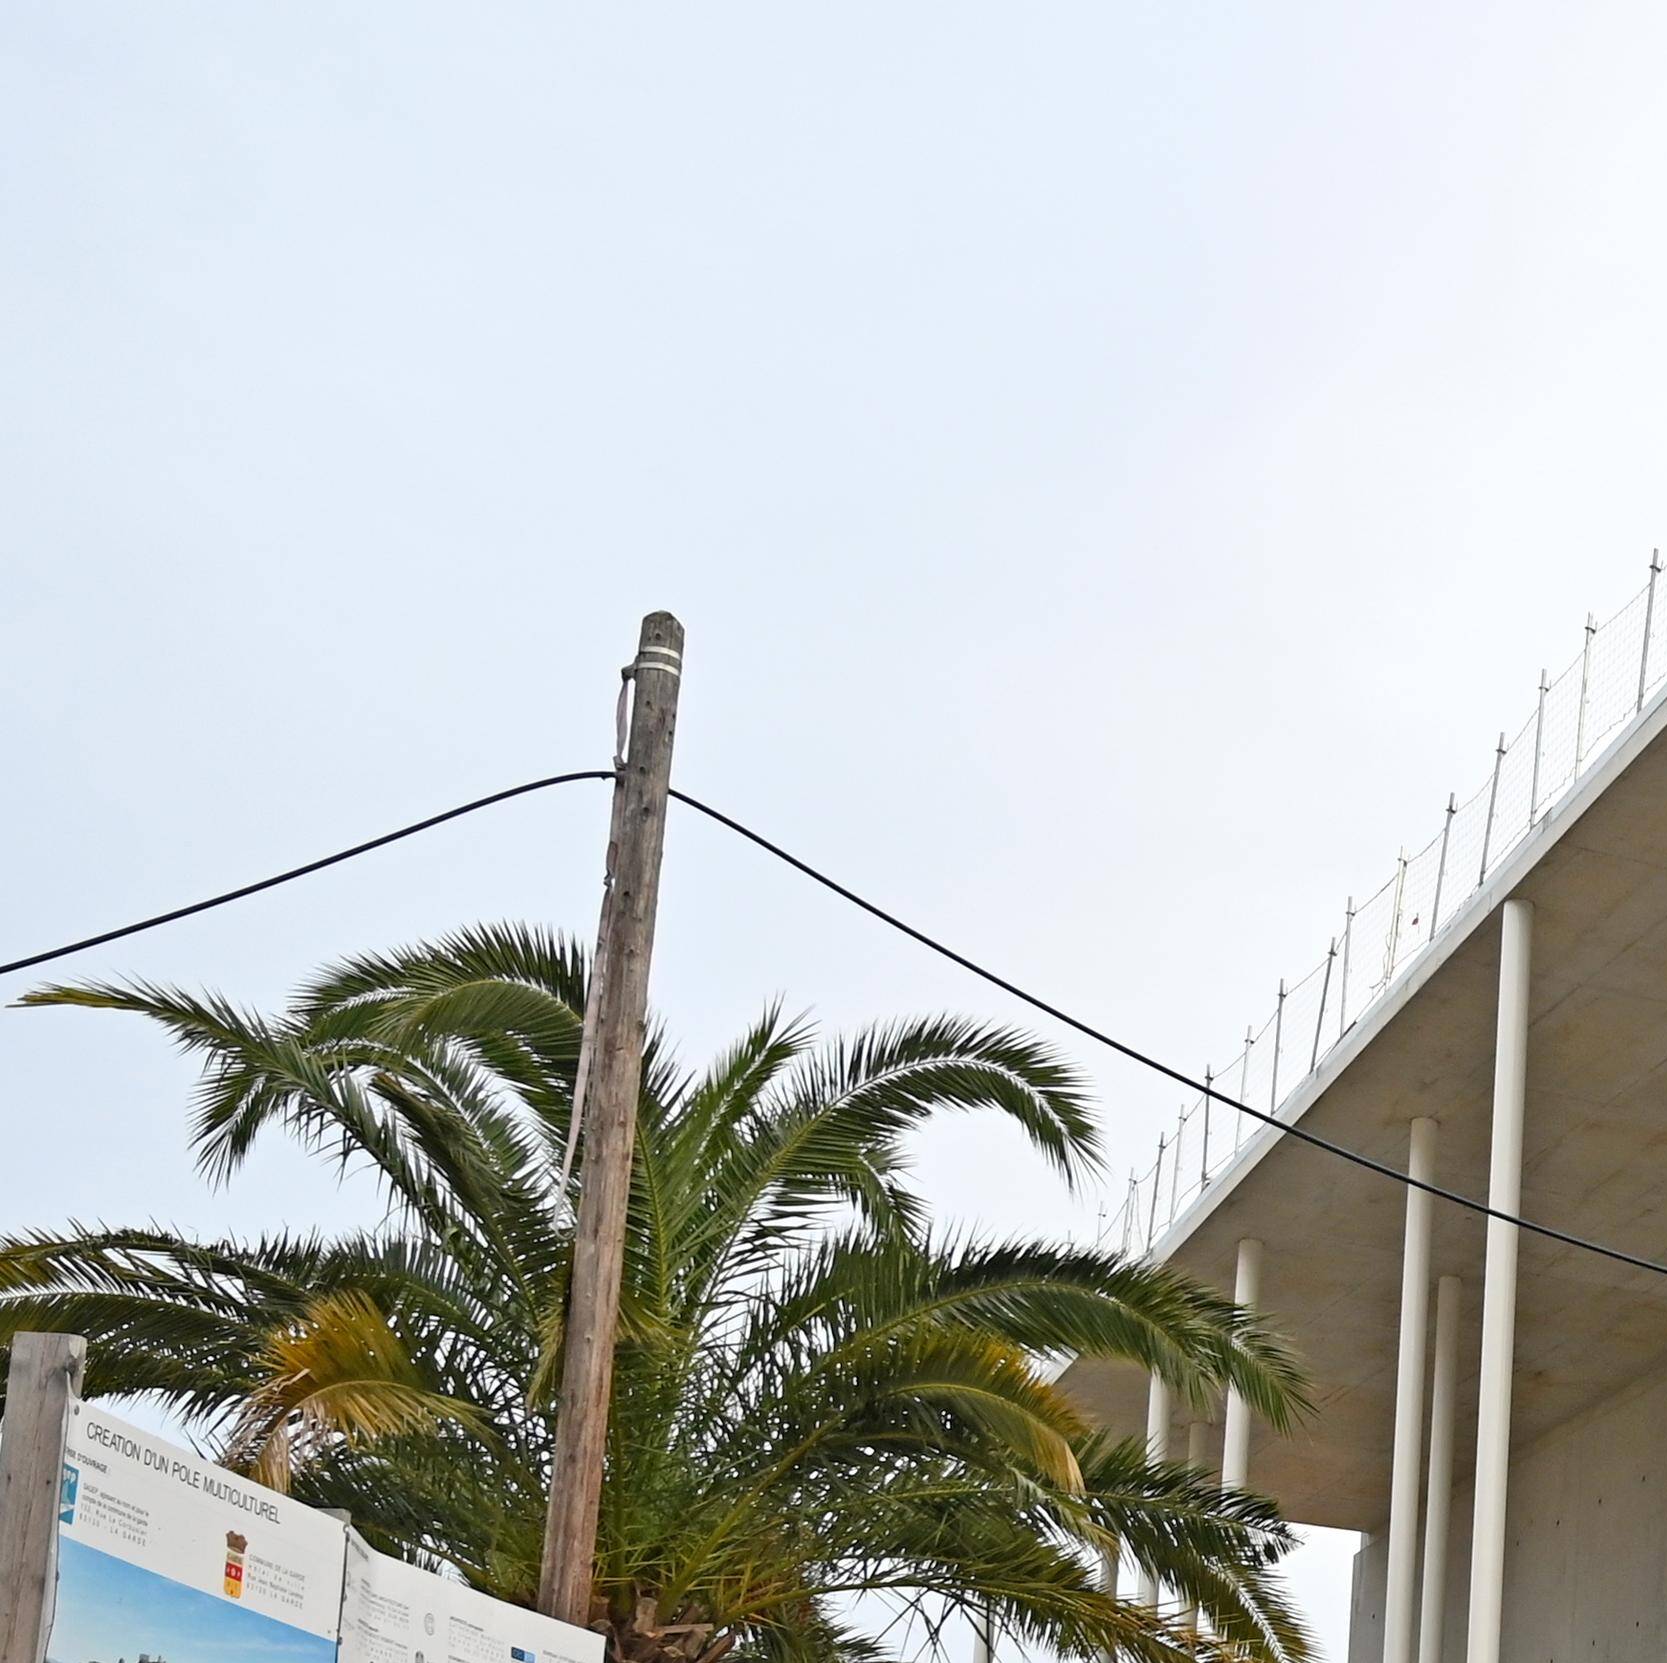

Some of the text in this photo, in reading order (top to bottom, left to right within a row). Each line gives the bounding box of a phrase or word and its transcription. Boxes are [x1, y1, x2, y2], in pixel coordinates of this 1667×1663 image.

[86, 1421, 142, 1462] CREATION
[144, 1449, 169, 1475] D'UN
[172, 1462, 200, 1489] POLE
[203, 1476, 281, 1524] MULTICULTUREL
